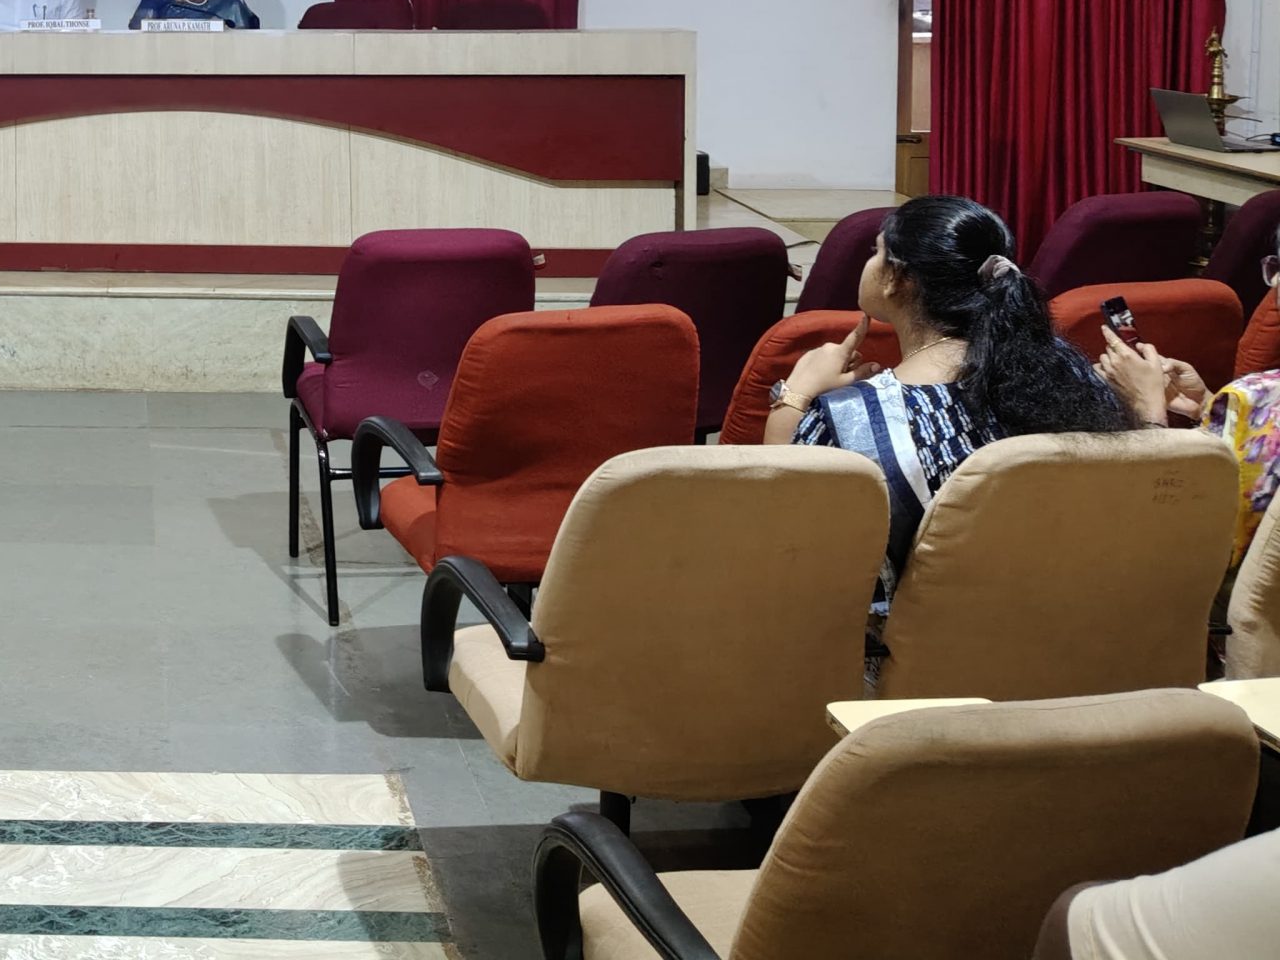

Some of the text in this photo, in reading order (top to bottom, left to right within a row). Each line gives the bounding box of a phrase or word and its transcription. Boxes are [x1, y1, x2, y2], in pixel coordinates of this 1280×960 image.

[45, 21, 65, 29] IQBAL
[66, 20, 89, 28] THONSE
[163, 22, 182, 32] ARUNA
[188, 22, 211, 31] KAMATH
